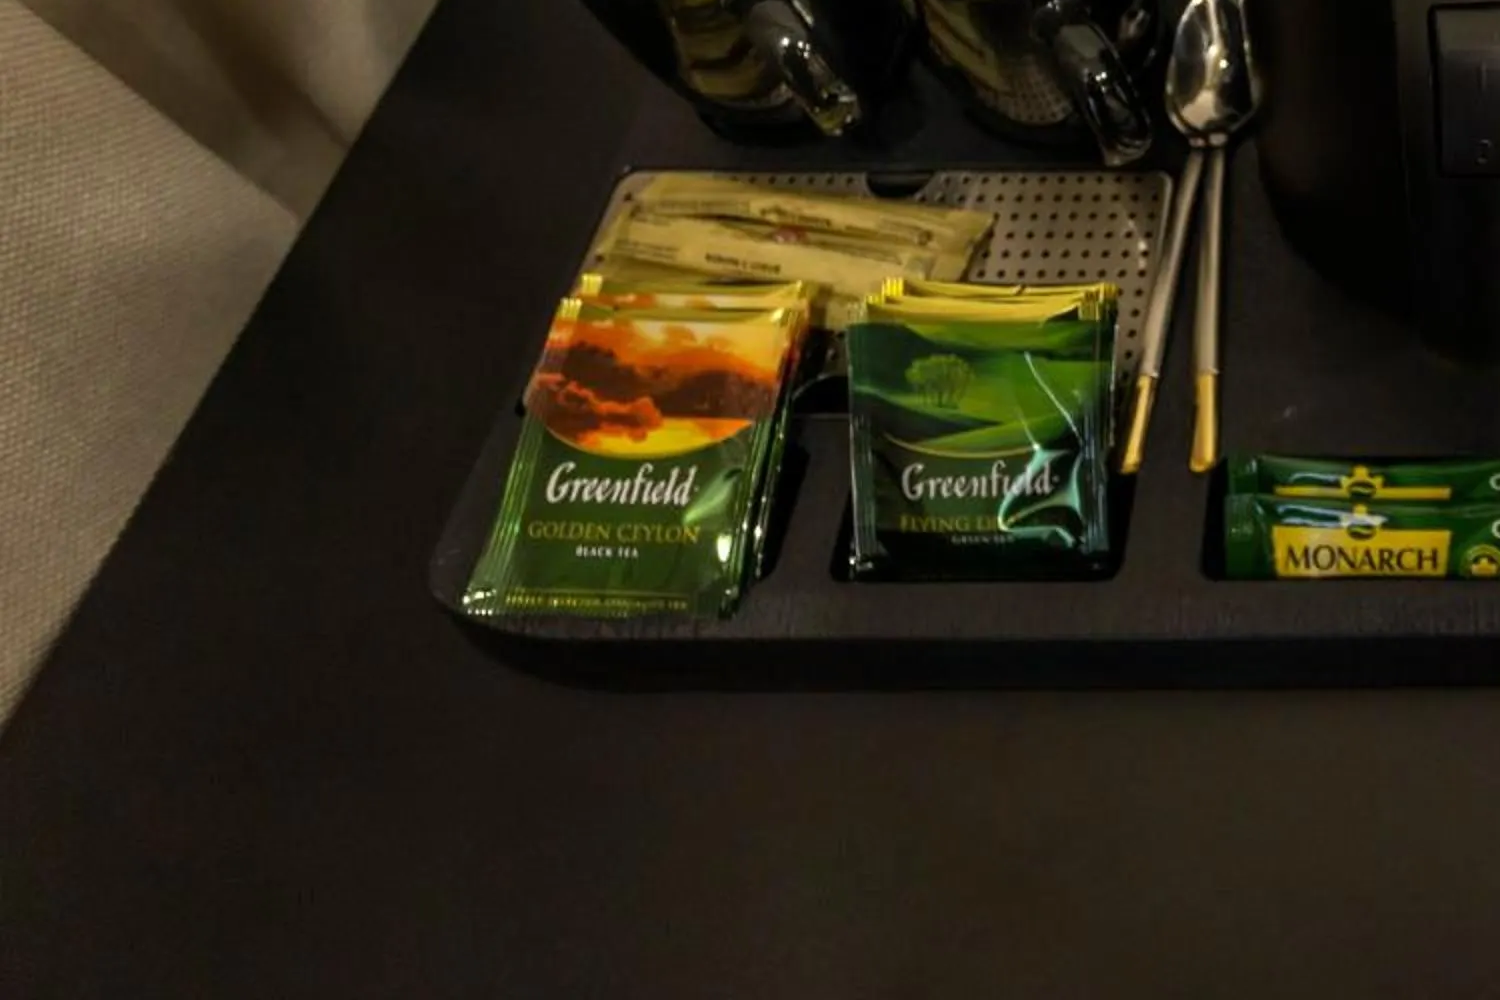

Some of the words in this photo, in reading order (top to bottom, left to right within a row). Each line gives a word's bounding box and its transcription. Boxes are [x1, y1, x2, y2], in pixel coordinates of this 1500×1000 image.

[546, 460, 698, 507] Greenfield
[901, 459, 1052, 501] Greenfield
[527, 519, 610, 541] GOLDEN
[616, 523, 701, 545] CEYLON
[900, 514, 972, 533] FLYING
[575, 544, 613, 558] BLACK
[618, 546, 639, 559] TEA
[1285, 544, 1438, 572] MONARCH
